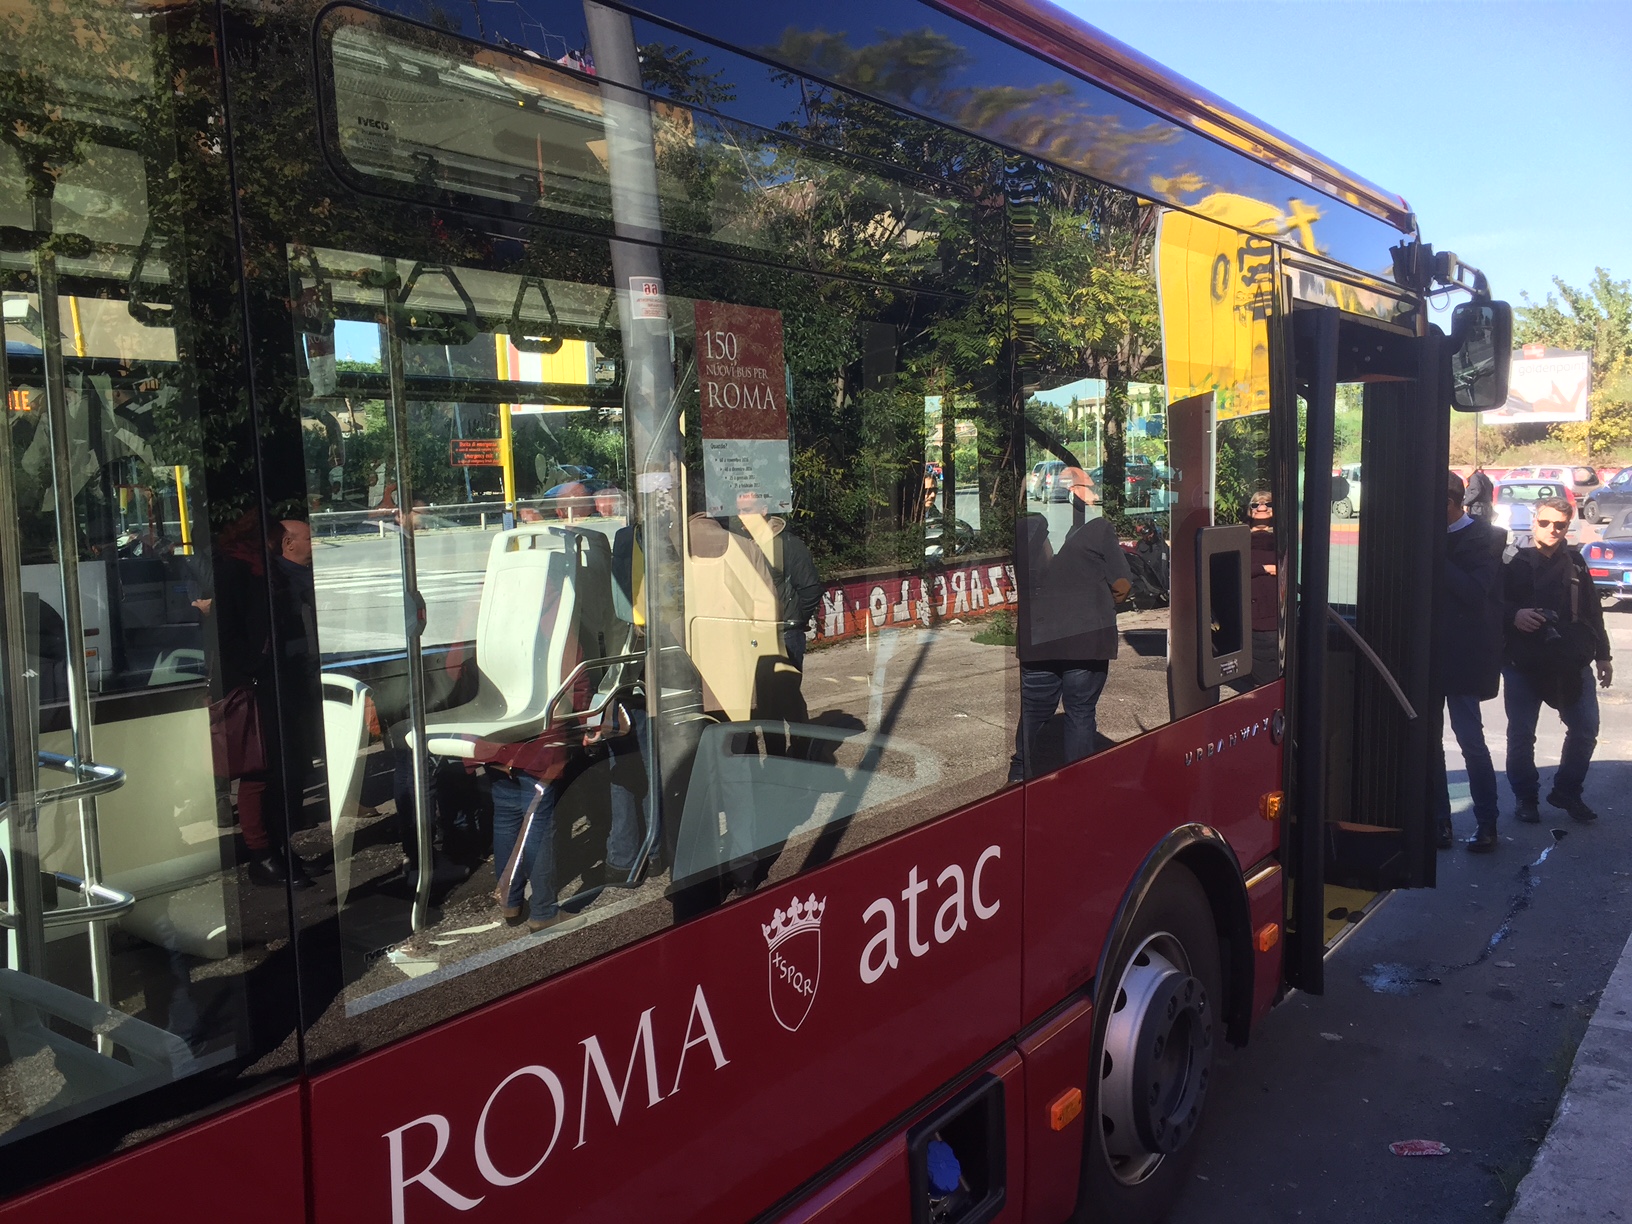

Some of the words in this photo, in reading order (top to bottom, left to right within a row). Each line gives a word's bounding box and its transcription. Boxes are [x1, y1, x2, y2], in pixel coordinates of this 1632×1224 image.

[358, 116, 389, 131] IVECO
[703, 330, 737, 361] 150
[706, 365, 735, 378] NUOVI
[736, 367, 752, 379] BUS
[753, 368, 769, 380] PER
[1518, 361, 1586, 377] goldenpoint
[708, 381, 777, 410] ROMA
[1185, 717, 1269, 767] URBANWAY
[859, 844, 1001, 984] atac
[381, 983, 731, 1224] ROMA
